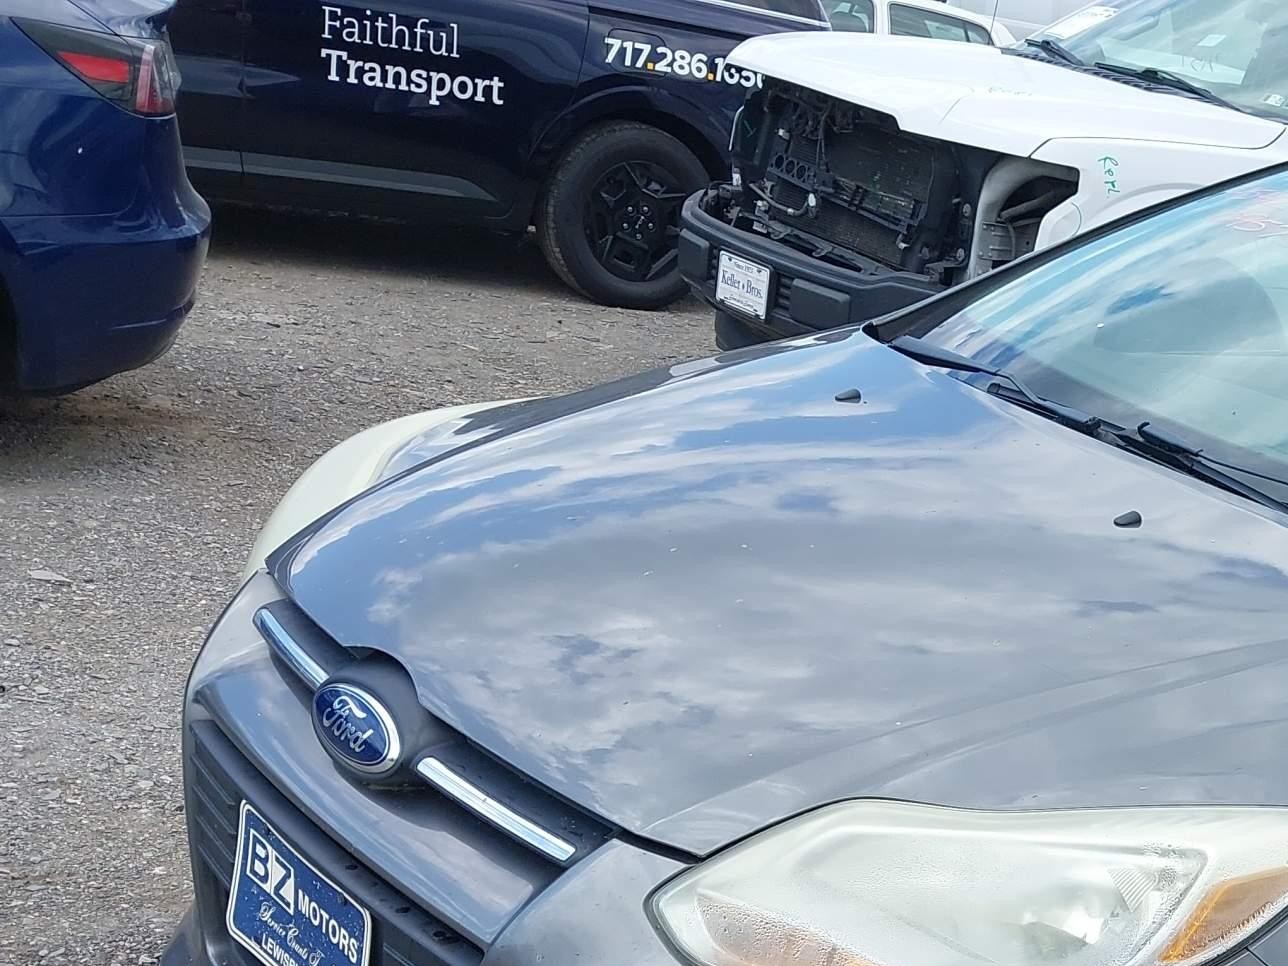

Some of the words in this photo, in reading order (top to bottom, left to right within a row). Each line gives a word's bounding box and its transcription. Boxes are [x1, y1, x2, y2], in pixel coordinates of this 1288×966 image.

[321, 5, 461, 58] Faithful
[320, 48, 505, 106] Transport
[721, 269, 741, 290] Keller
[322, 695, 374, 753] Ford
[247, 829, 295, 916] BZ
[297, 889, 358, 964] MOTORS
